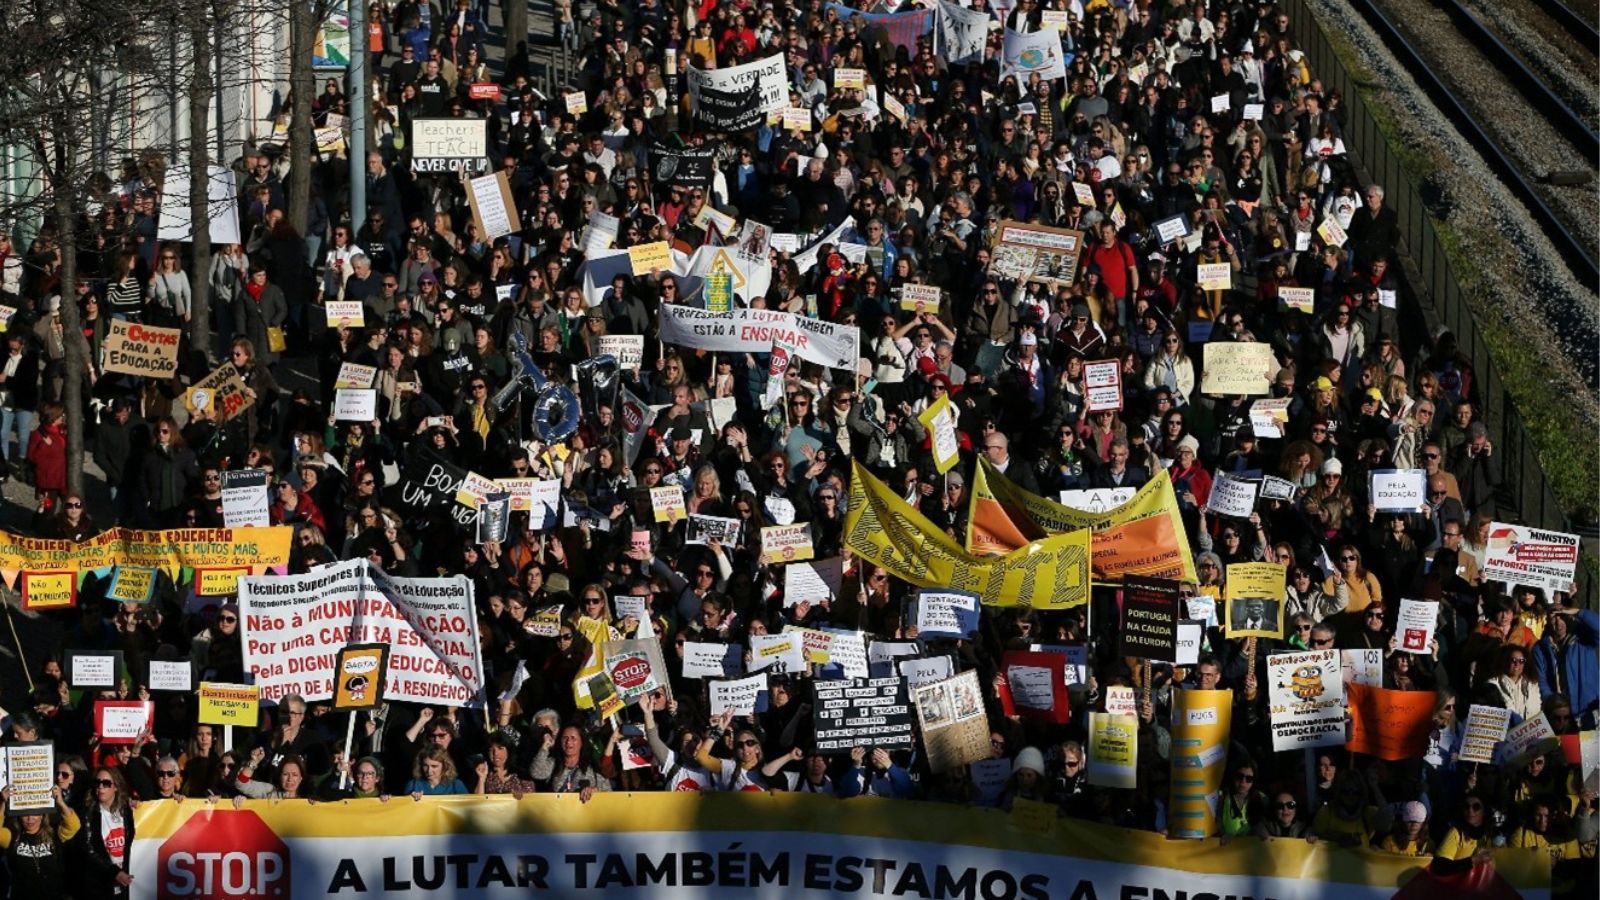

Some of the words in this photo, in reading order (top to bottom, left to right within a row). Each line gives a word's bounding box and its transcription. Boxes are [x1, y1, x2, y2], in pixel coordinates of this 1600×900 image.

[425, 142, 479, 156] TEACH
[410, 158, 446, 172] NEVER
[476, 158, 488, 172] UP
[112, 325, 126, 336] DE
[694, 320, 725, 336] ESTÃO
[728, 324, 736, 336] A
[741, 326, 809, 350] ENSINAR
[121, 340, 151, 355] PARA
[154, 346, 162, 356] A
[109, 350, 175, 372] EDUCAÇÃO
[1388, 482, 1406, 490] PELA
[402, 480, 433, 507] UM
[1090, 492, 1104, 504] A
[1378, 490, 1418, 498] EDUCAÇÃO
[166, 528, 232, 544] EDUCAÇÃO
[775, 526, 807, 538] LUTAR
[1530, 532, 1576, 546] MINISTRO
[1488, 558, 1529, 572] AUTORIZE
[248, 580, 295, 596] Técnicos
[298, 568, 353, 592] Superiores
[415, 584, 464, 599] Educação
[247, 613, 284, 632] Não
[292, 612, 303, 629] à
[1128, 608, 1172, 623] PORTUGAL
[1126, 622, 1138, 632] NA
[1140, 624, 1172, 636] CAUDA
[802, 631, 832, 643] UTAR
[1126, 634, 1138, 644] DA
[1138, 636, 1172, 648] EUROPA
[248, 639, 275, 656] Por
[282, 638, 314, 653] uma
[396, 629, 474, 660] ESPCIAL,
[250, 663, 284, 679] Pela
[389, 654, 477, 681] EDUCAÇÃO,
[614, 662, 648, 681] STOP
[260, 682, 302, 700] IREITO
[305, 681, 320, 694] DE
[391, 676, 400, 694] À
[1110, 690, 1119, 700] A
[1276, 724, 1341, 738] DEMOCRACIA,
[1511, 718, 1544, 742] LUTAR
[326, 857, 368, 894] A
[382, 854, 550, 892] LUTAR
[564, 842, 790, 889] TAMBÉM
[804, 853, 1050, 900] ESTAMOS
[1070, 878, 1098, 900] A
